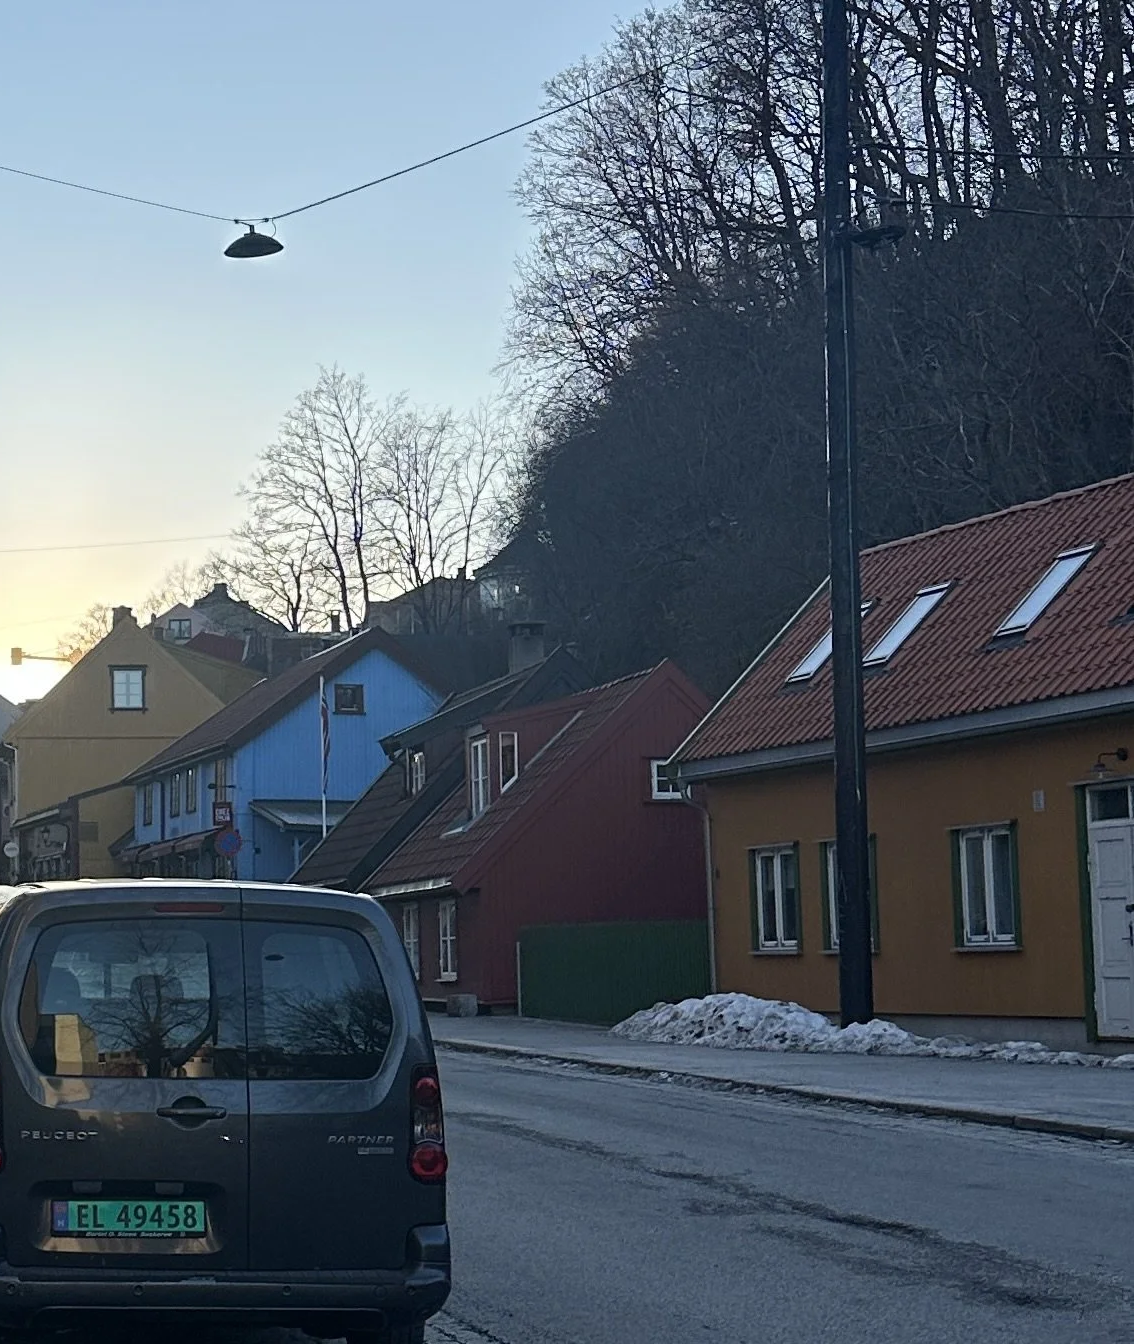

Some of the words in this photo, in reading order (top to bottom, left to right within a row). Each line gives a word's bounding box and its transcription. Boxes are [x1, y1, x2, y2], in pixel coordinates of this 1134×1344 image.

[327, 1135, 394, 1145] PARTNER
[76, 1204, 105, 1229] EL
[116, 1204, 198, 1229] 49458
